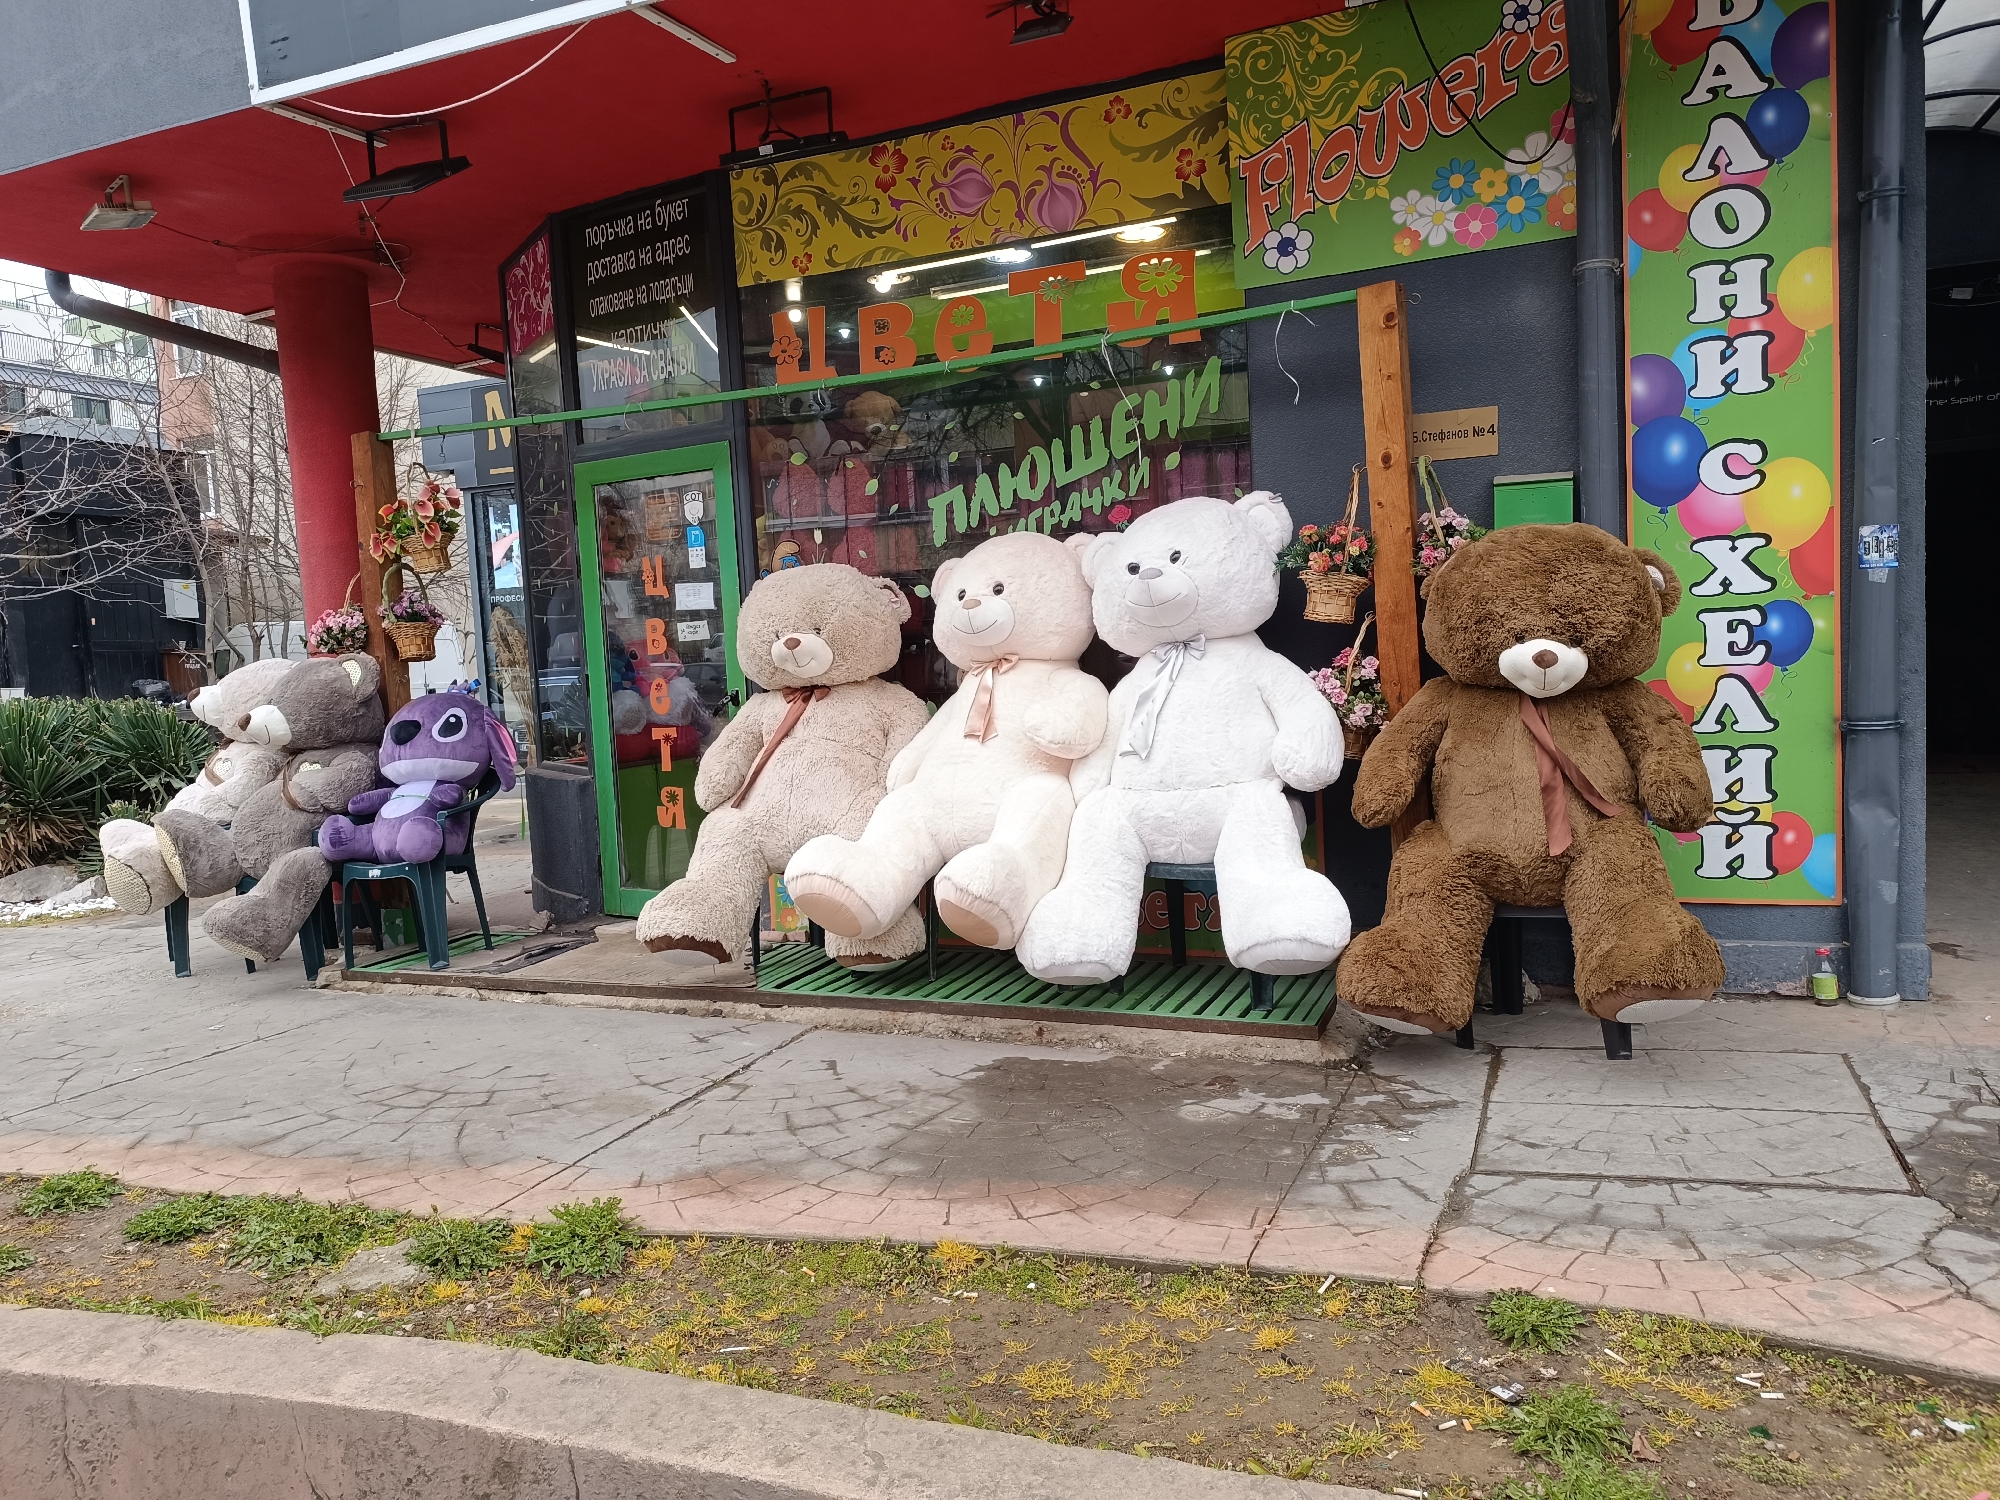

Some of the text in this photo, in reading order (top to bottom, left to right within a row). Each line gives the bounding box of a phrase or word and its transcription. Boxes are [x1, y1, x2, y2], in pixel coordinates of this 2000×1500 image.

[1237, 2, 1570, 259] Flowers
[585, 198, 689, 249] поръчка на букет
[587, 233, 691, 286] доставка на адрес
[589, 272, 694, 318] опаковане на подаръци
[611, 317, 676, 351] картички
[590, 342, 696, 393] УКРАСИ ЗА СВАТБИ
[927, 355, 1222, 548] ПЛЮШЕНИ
